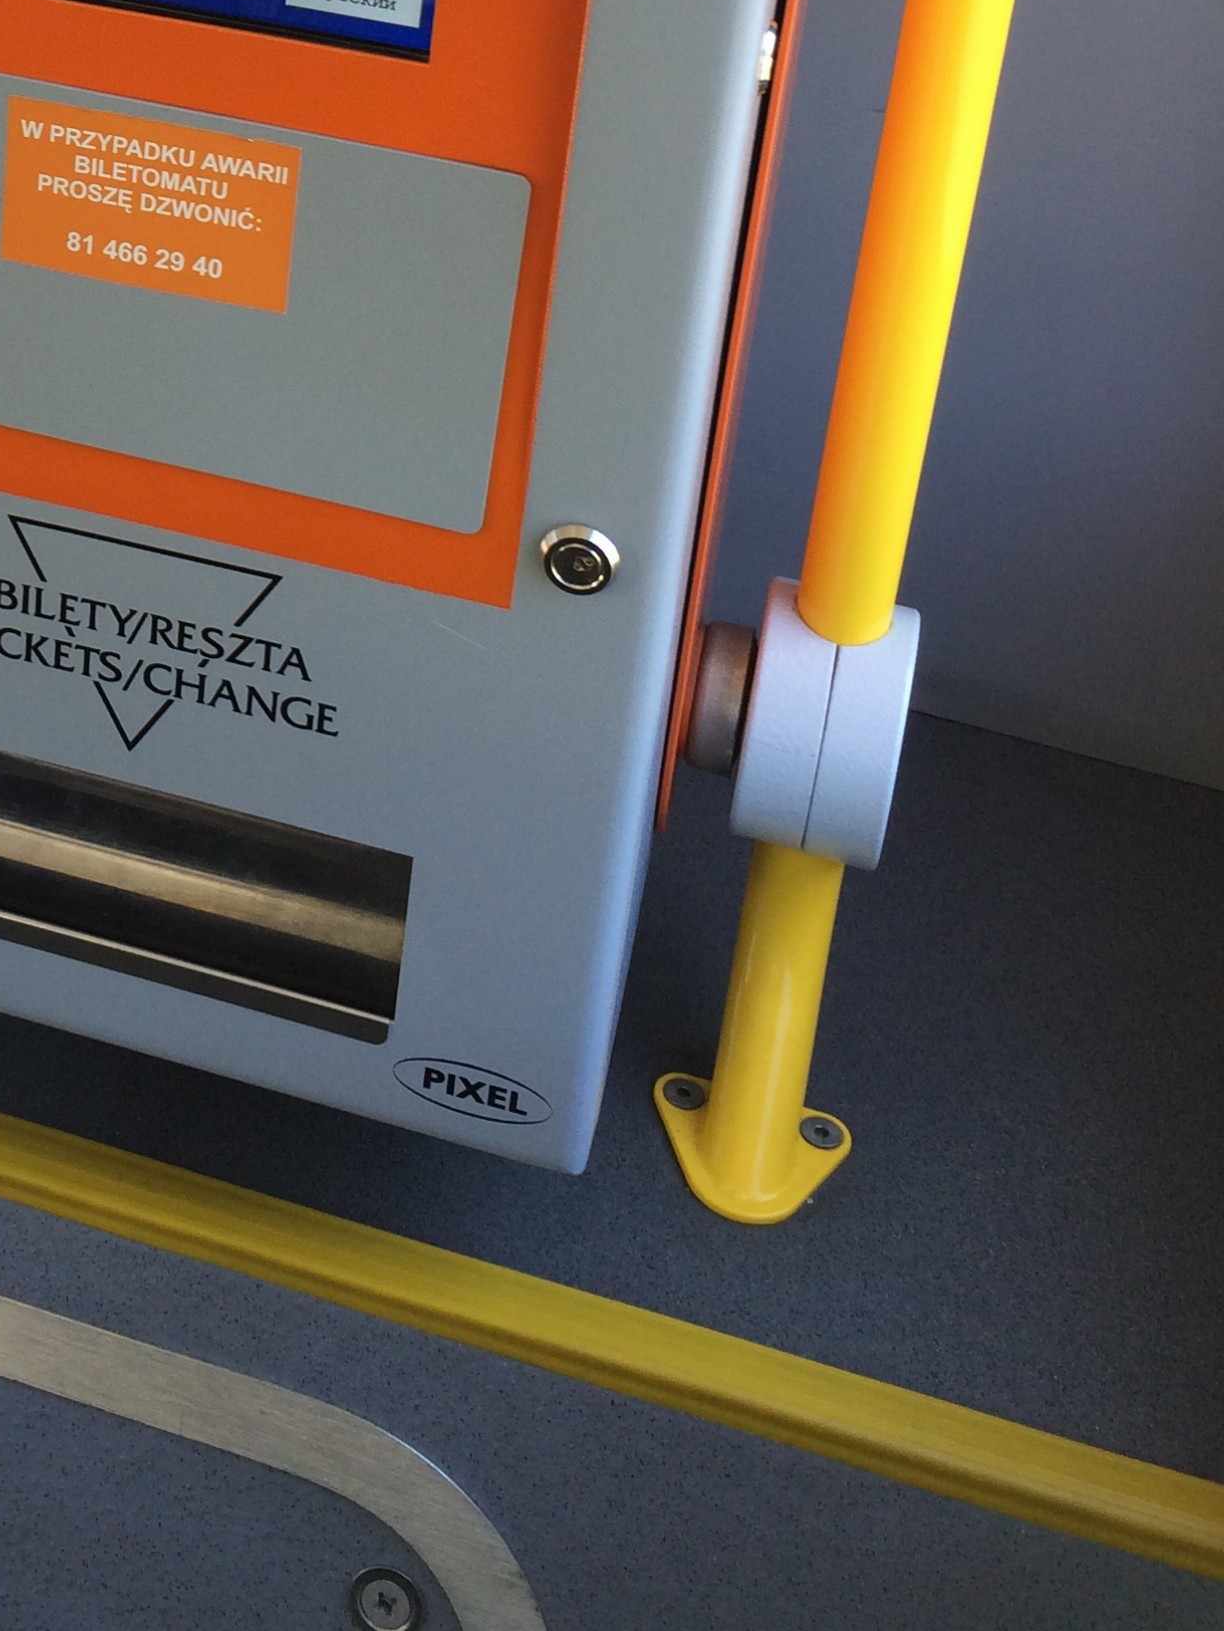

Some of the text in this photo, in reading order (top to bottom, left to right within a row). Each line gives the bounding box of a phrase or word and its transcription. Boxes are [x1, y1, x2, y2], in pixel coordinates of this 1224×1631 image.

[20, 119, 290, 186] W PRZYPADKU AWARII
[74, 154, 229, 200] BILETOMATU
[37, 173, 263, 233] PROSZĘ DZWONIĆ:
[66, 231, 223, 280] 81 466 29 40
[422, 1067, 528, 1117] PIXEL
